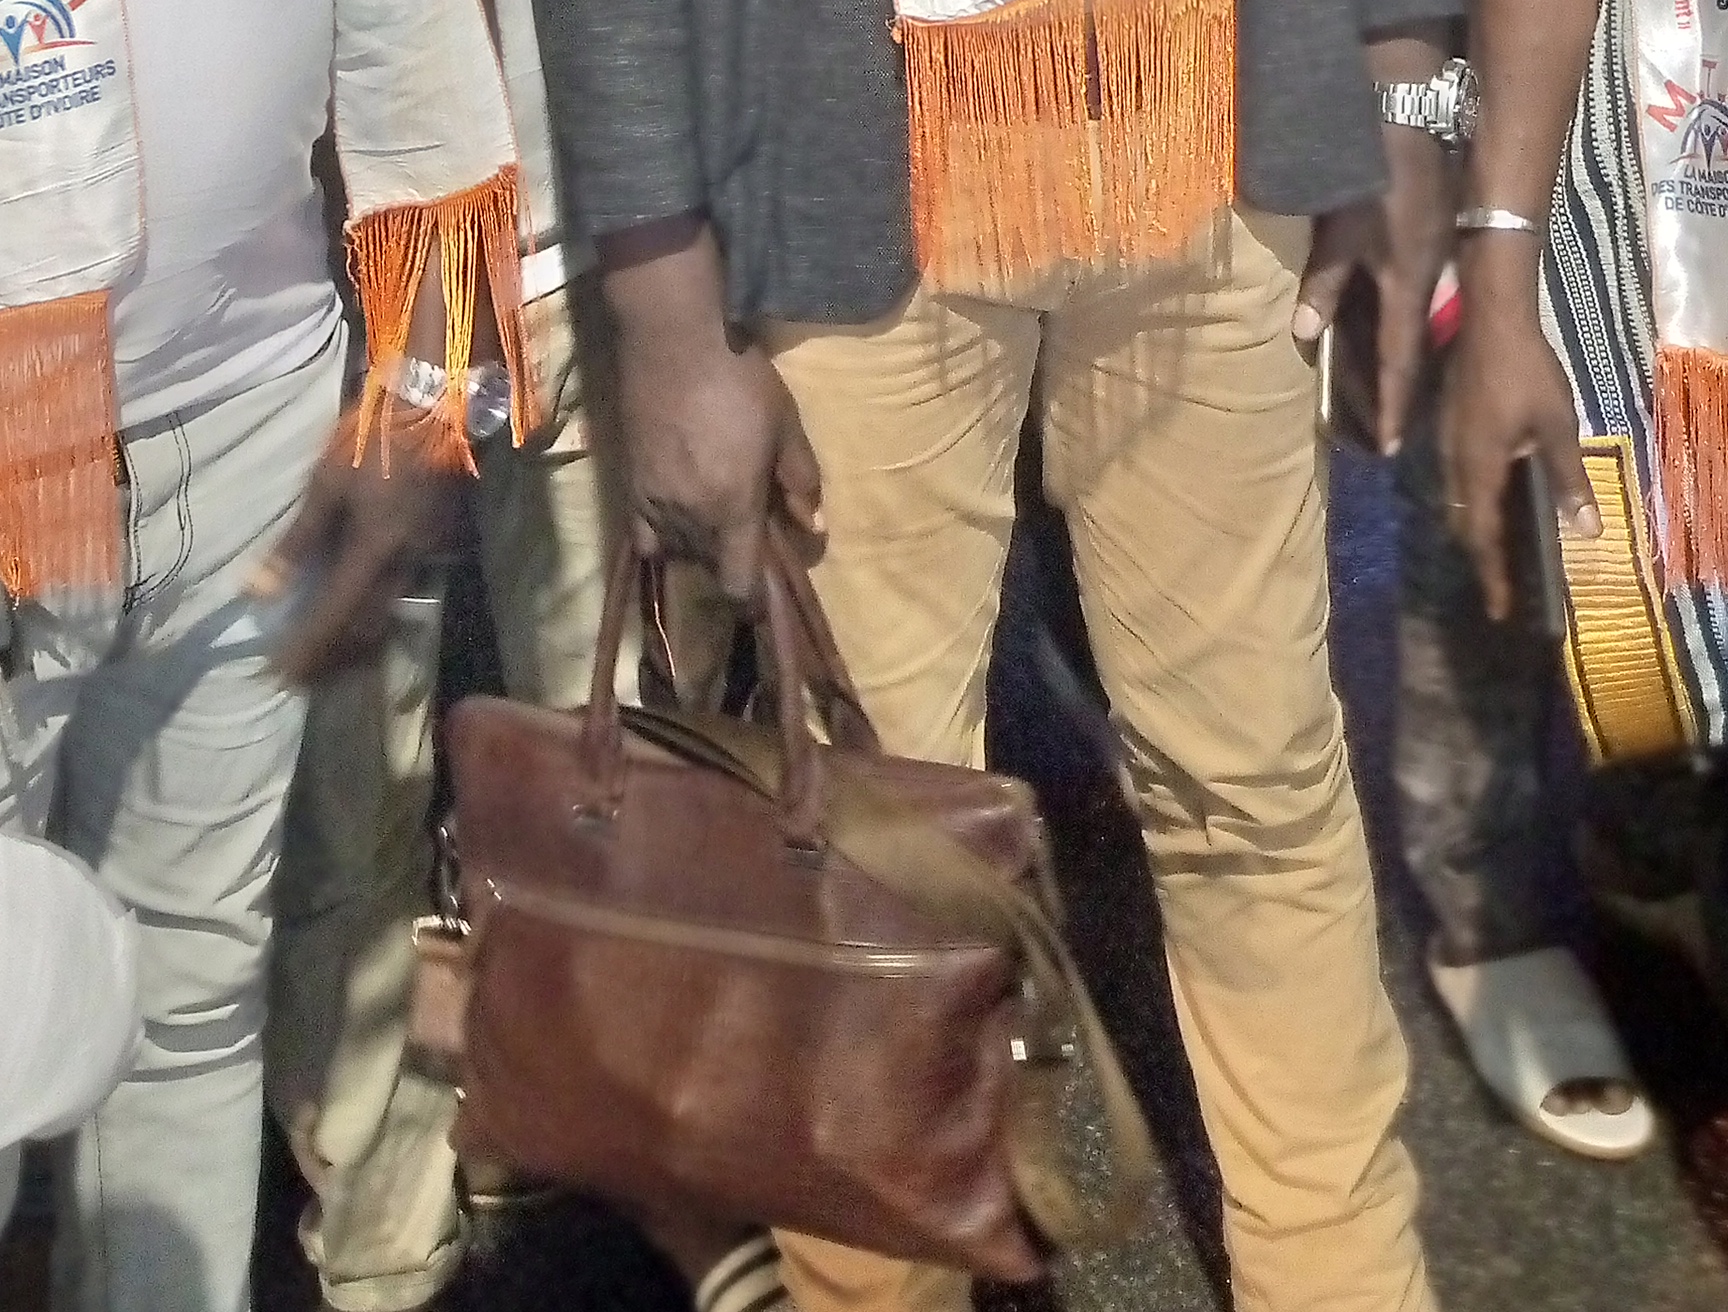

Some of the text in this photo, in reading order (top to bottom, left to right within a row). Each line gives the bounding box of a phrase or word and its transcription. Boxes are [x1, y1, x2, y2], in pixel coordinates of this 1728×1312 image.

[0, 59, 117, 109] NSPORTEURS
[1684, 163, 1698, 181] LA
[1651, 179, 1675, 196] DES
[1665, 196, 1684, 212] DE
[1687, 197, 1718, 217] CÔTE
